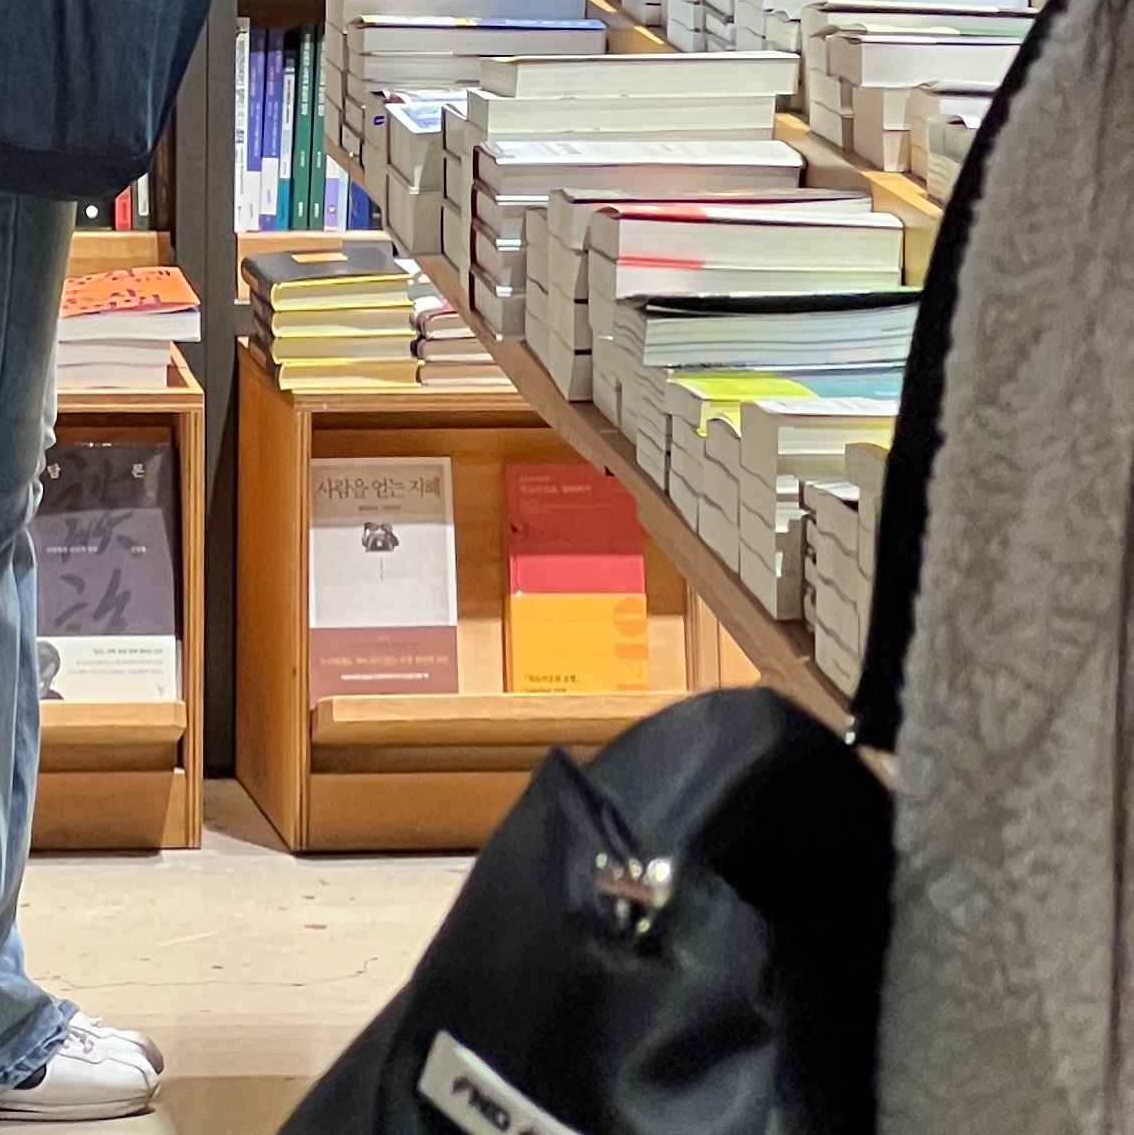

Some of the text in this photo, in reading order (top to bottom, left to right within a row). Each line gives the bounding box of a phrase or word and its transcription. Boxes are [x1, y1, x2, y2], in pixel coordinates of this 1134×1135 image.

[317, 477, 441, 500] 사람을 얻는 지혜
